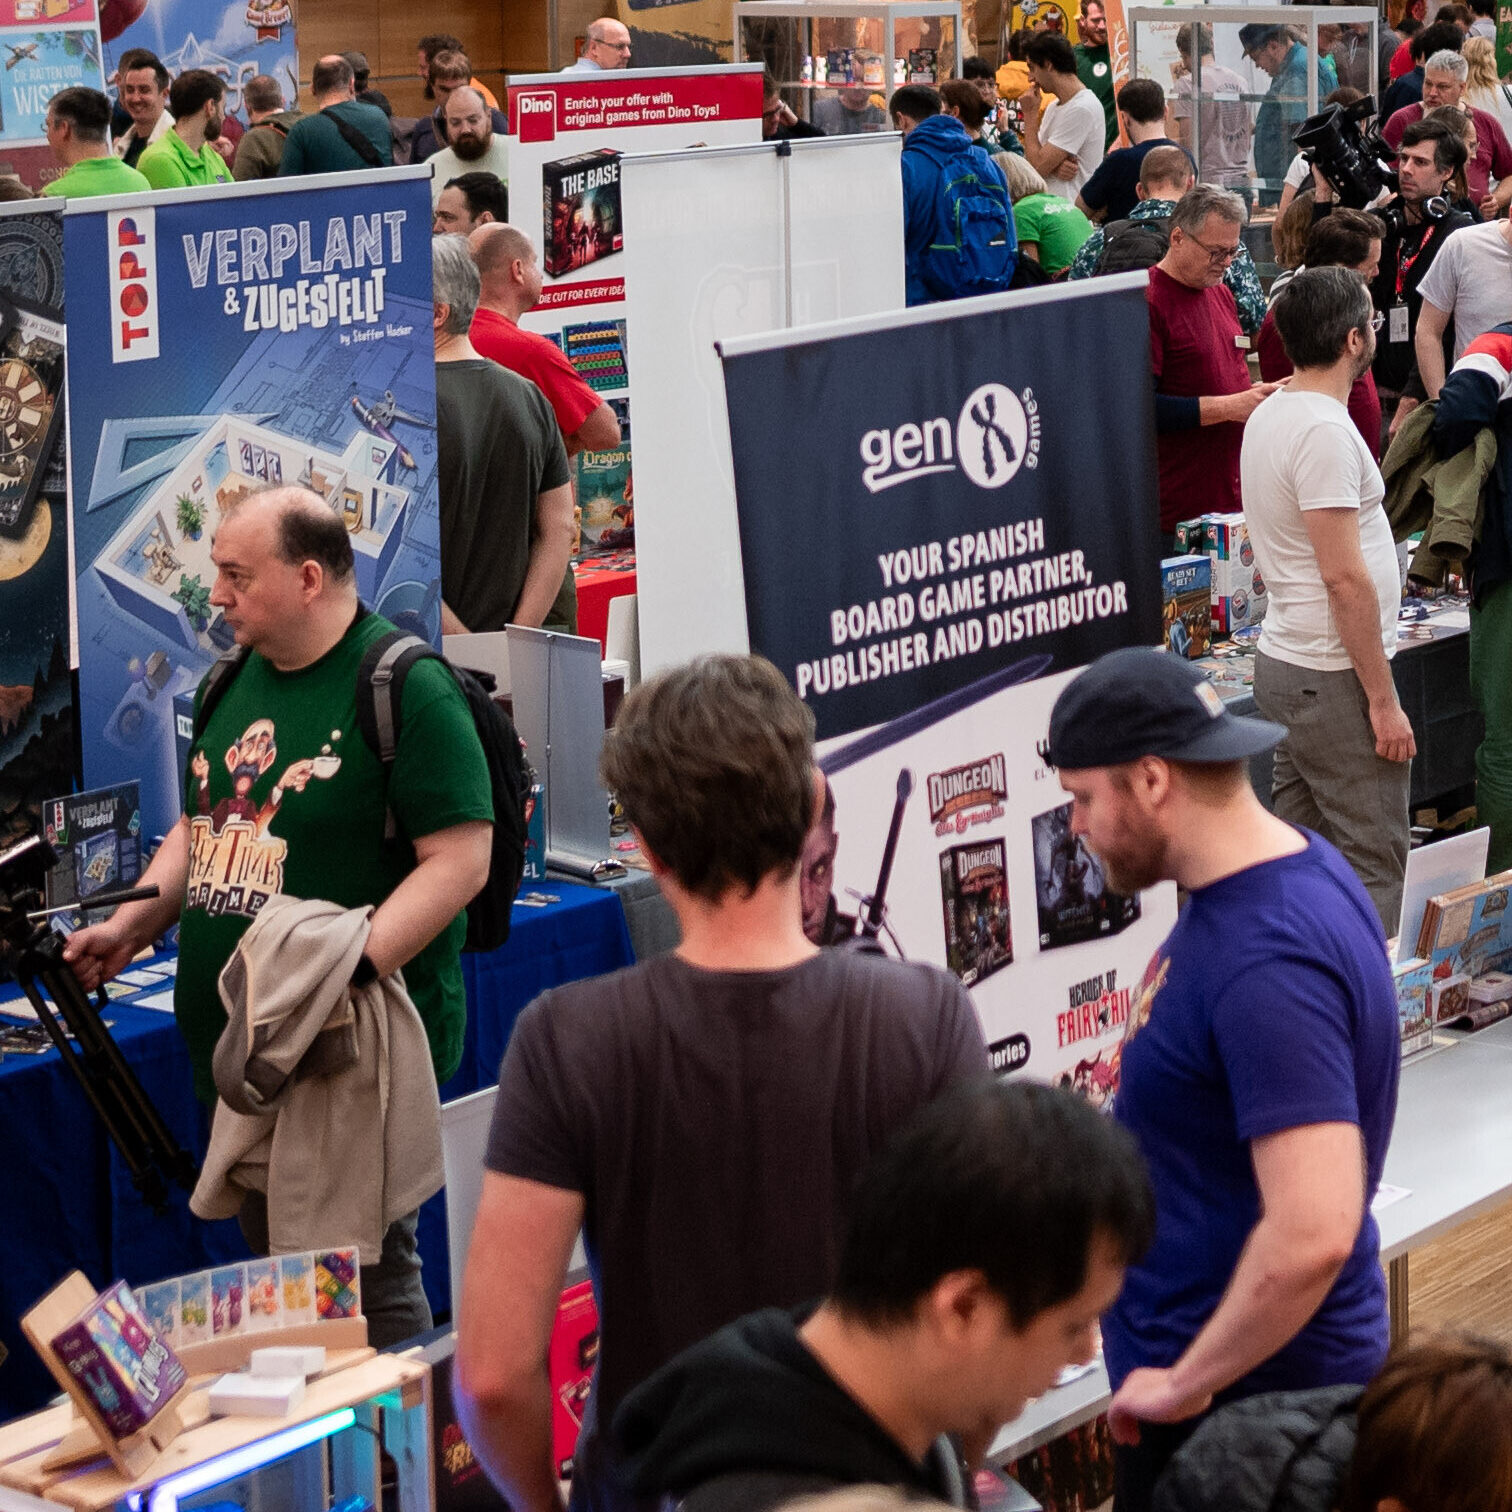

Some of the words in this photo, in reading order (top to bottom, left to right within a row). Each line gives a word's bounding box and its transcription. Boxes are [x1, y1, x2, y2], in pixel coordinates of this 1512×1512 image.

[13, 68, 28, 83] DIE
[29, 66, 63, 81] RATTEN
[63, 65, 83, 79] VON
[521, 96, 553, 114] Dino
[565, 97, 599, 110] Enrich
[600, 97, 624, 112] your
[626, 93, 651, 106] offer
[652, 92, 674, 104] with
[565, 110, 604, 127] original
[606, 110, 640, 125] games
[642, 107, 667, 120] from
[667, 105, 691, 118] Dino
[692, 103, 721, 118] Toys!
[560, 171, 586, 199] THE
[587, 162, 620, 191] BASE
[182, 209, 407, 289] VERPLANT
[118, 216, 150, 350] TOPP
[538, 291, 552, 305] DIE
[552, 290, 568, 304] CUT
[568, 288, 584, 302] FOR
[584, 286, 608, 300] EVERY
[224, 287, 241, 316] &
[243, 267, 387, 333] ZUGESTELLT
[340, 332, 351, 346] by
[352, 325, 384, 344] Steffen
[1020, 386, 1042, 472] games
[583, 449, 624, 471] Dragon
[859, 416, 956, 494] gen
[877, 539, 945, 589] YOUR
[946, 516, 1045, 574] SPANISH
[830, 591, 915, 646] BOARD
[918, 573, 987, 623] GAME
[989, 548, 1093, 606] PARTNER,
[1176, 575, 1189, 587] BET
[795, 631, 930, 700] PUBLISHER
[932, 617, 984, 663] AND
[985, 580, 1129, 649] DISTRIBUTOR
[928, 754, 1007, 821] DUNGEON
[69, 796, 119, 822] VERPLANT
[522, 861, 540, 879] EL
[957, 844, 1003, 880] DUNGEON
[187, 885, 271, 918] CRIME
[1105, 969, 1118, 994] OF
[1056, 1002, 1101, 1048] FAIRY
[989, 1042, 1028, 1070] ories
